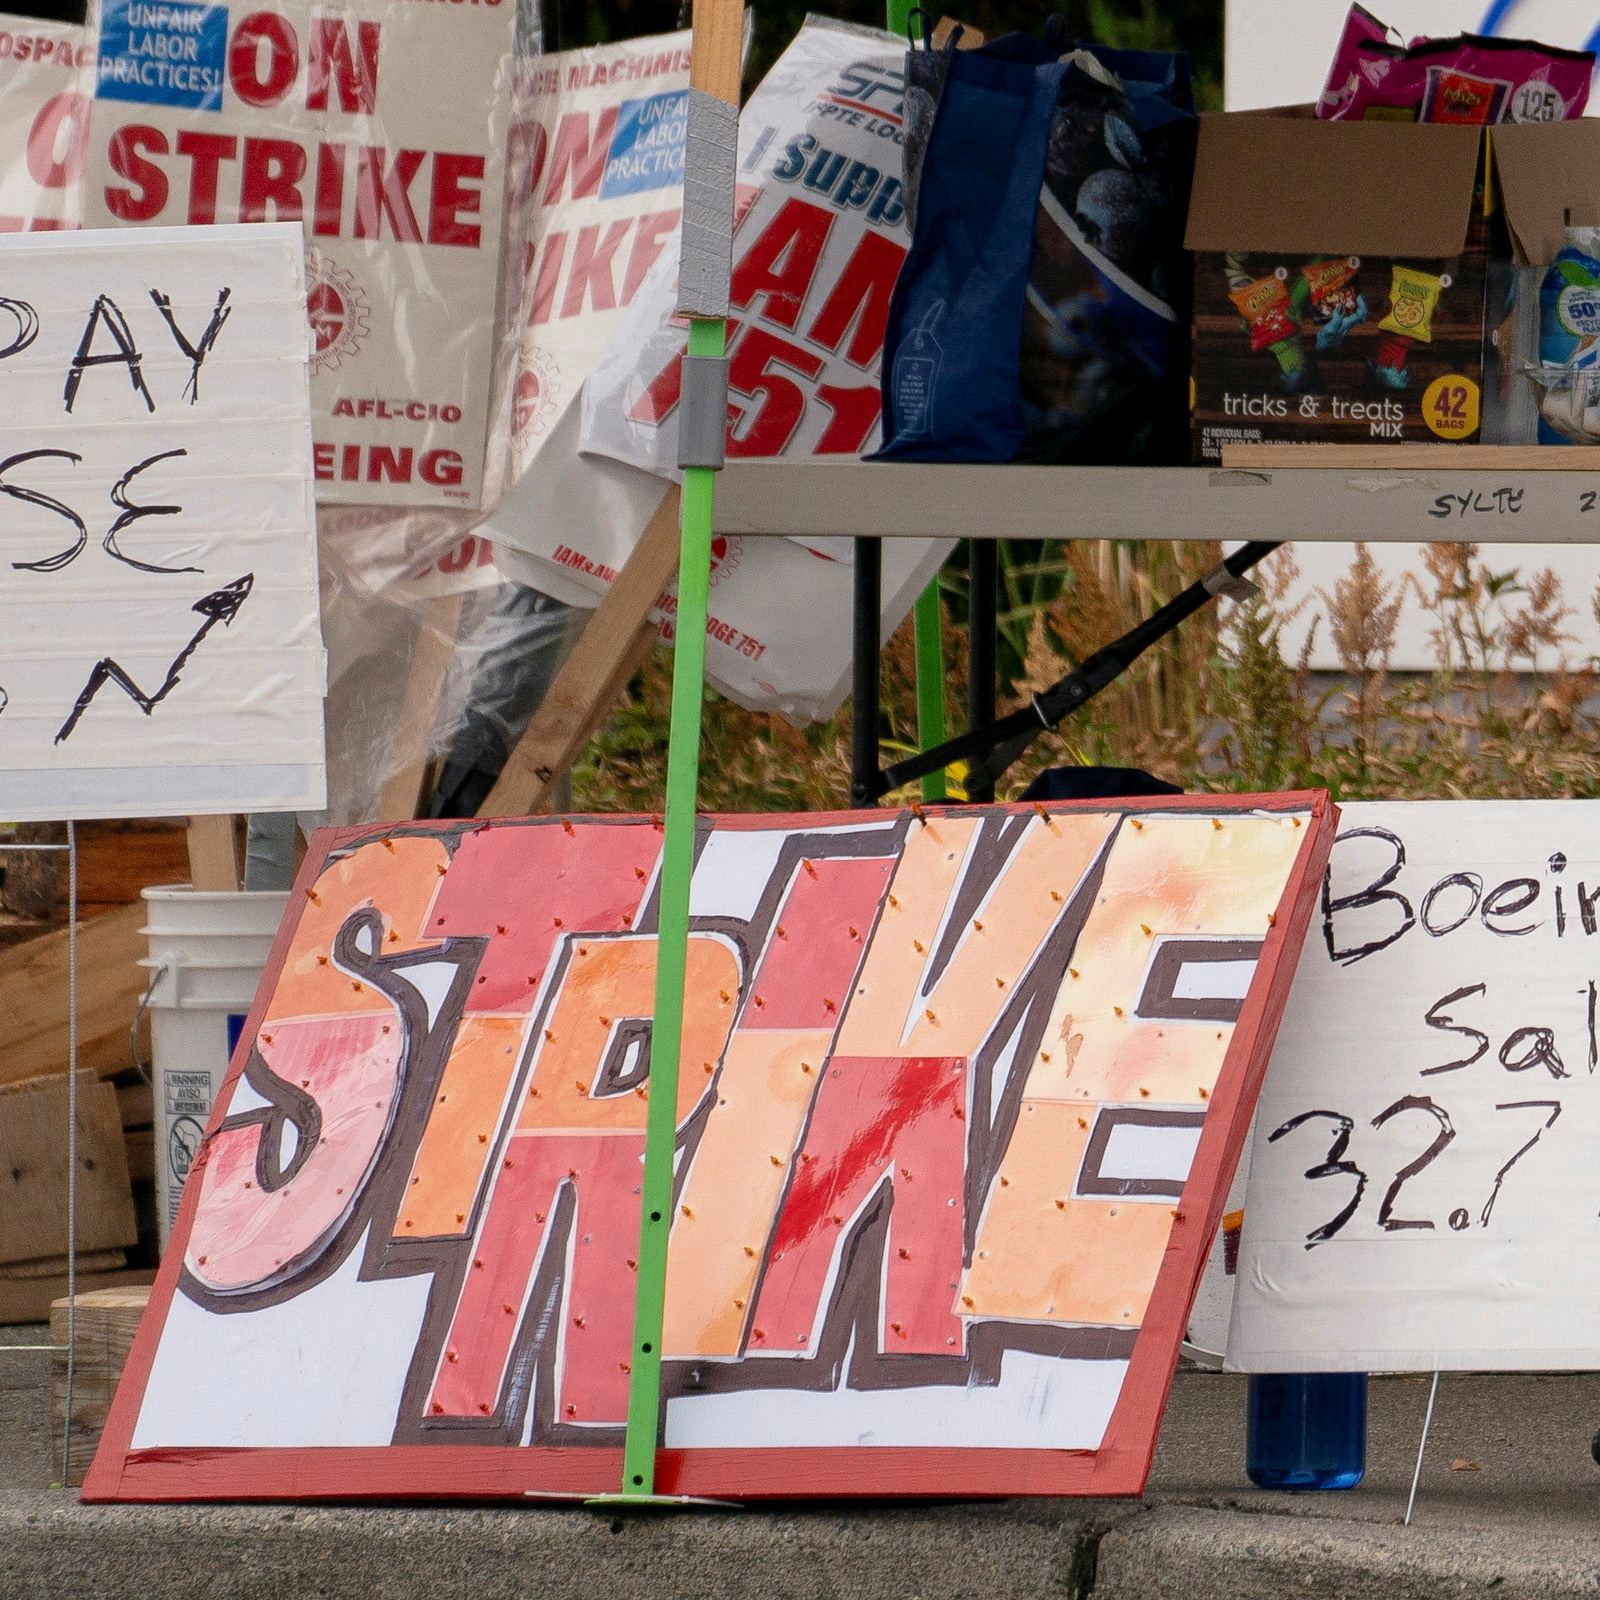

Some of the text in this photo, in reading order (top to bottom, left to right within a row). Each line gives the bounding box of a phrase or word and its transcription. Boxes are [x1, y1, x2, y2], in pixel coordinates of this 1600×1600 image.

[126, 2, 382, 115] UNFAIR ON
[127, 31, 197, 63] LABOR
[100, 56, 222, 95] PRACTICES!
[567, 49, 691, 93] MACHINIS
[1520, 87, 1557, 122] 125
[633, 120, 690, 151] LABO
[104, 123, 486, 249] STRIKE
[772, 133, 905, 226] Supp
[331, 397, 462, 425] AFL-CIO
[1224, 393, 1404, 421] tricks & treats
[1433, 386, 1468, 419] 42
[1370, 422, 1403, 438] MIX
[1436, 419, 1465, 430] BAGS
[313, 443, 464, 486] EING
[736, 634, 767, 662] 751
[180, 812, 1312, 1445] STRIKE
[1268, 1095, 1563, 1251] 32.7
